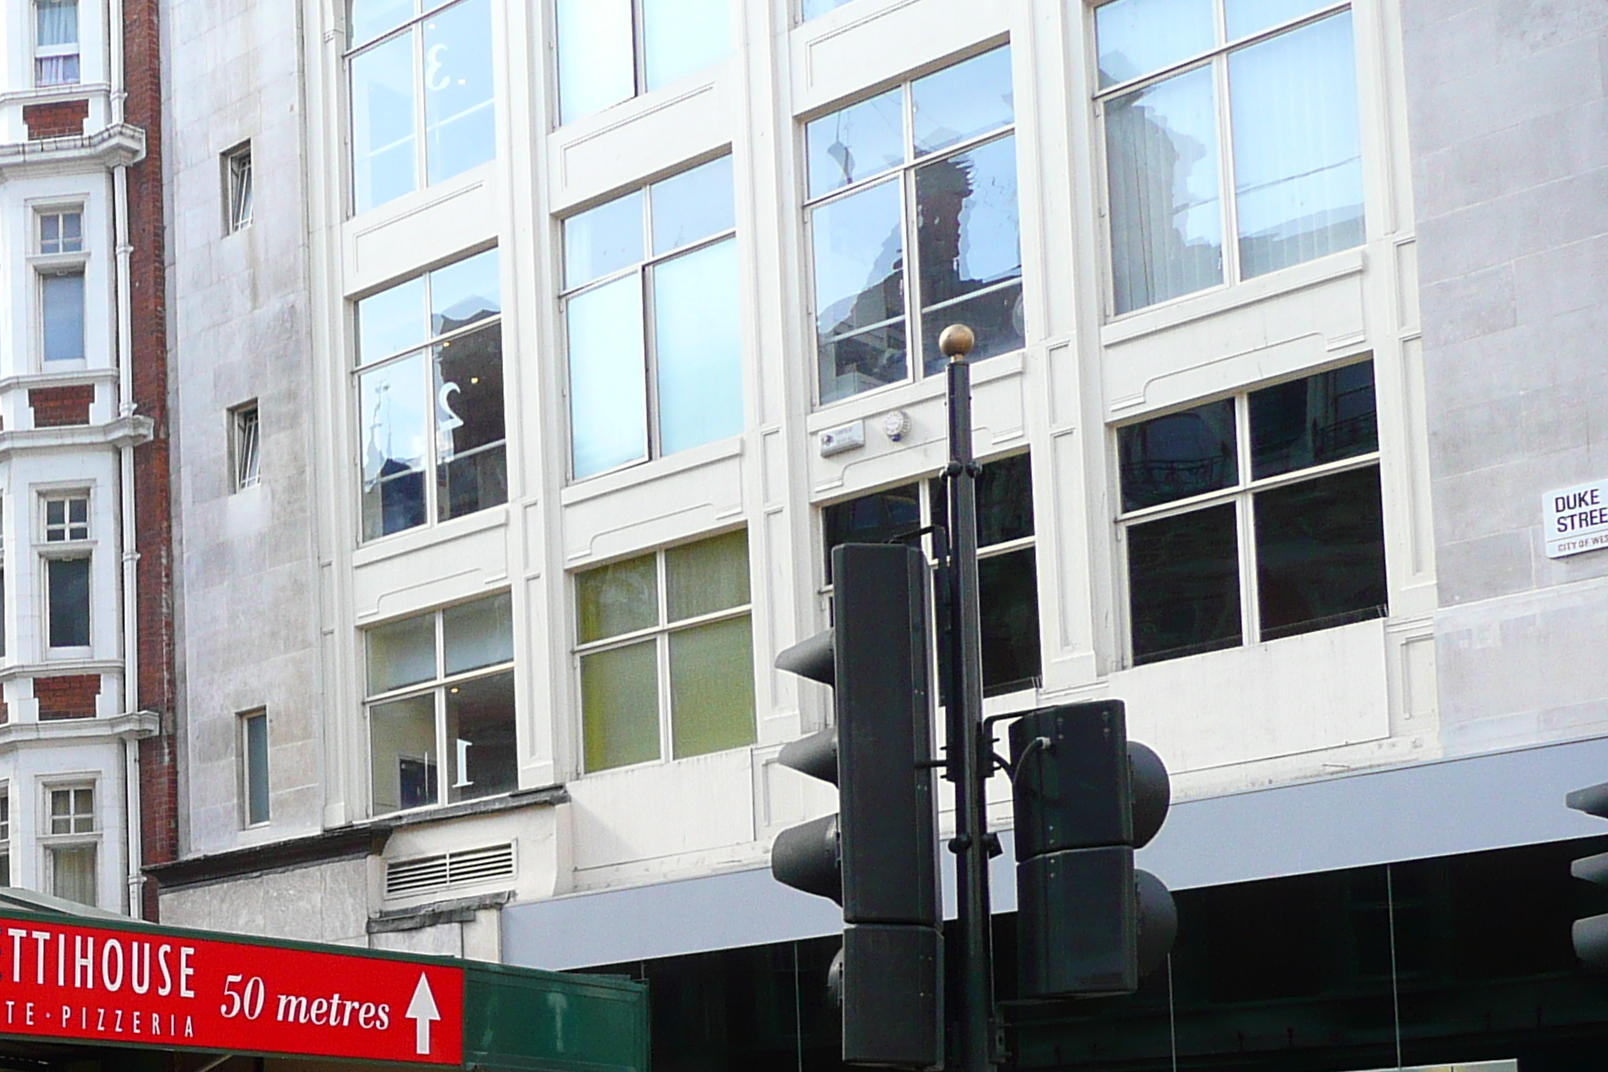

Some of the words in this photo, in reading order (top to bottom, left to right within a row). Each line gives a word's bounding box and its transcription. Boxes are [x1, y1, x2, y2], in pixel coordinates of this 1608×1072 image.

[1555, 489, 1600, 513] DUKE
[1558, 541, 1577, 552] CITY
[1579, 539, 1589, 548] OF
[221, 974, 264, 1020] 50
[277, 993, 390, 1030] metres
